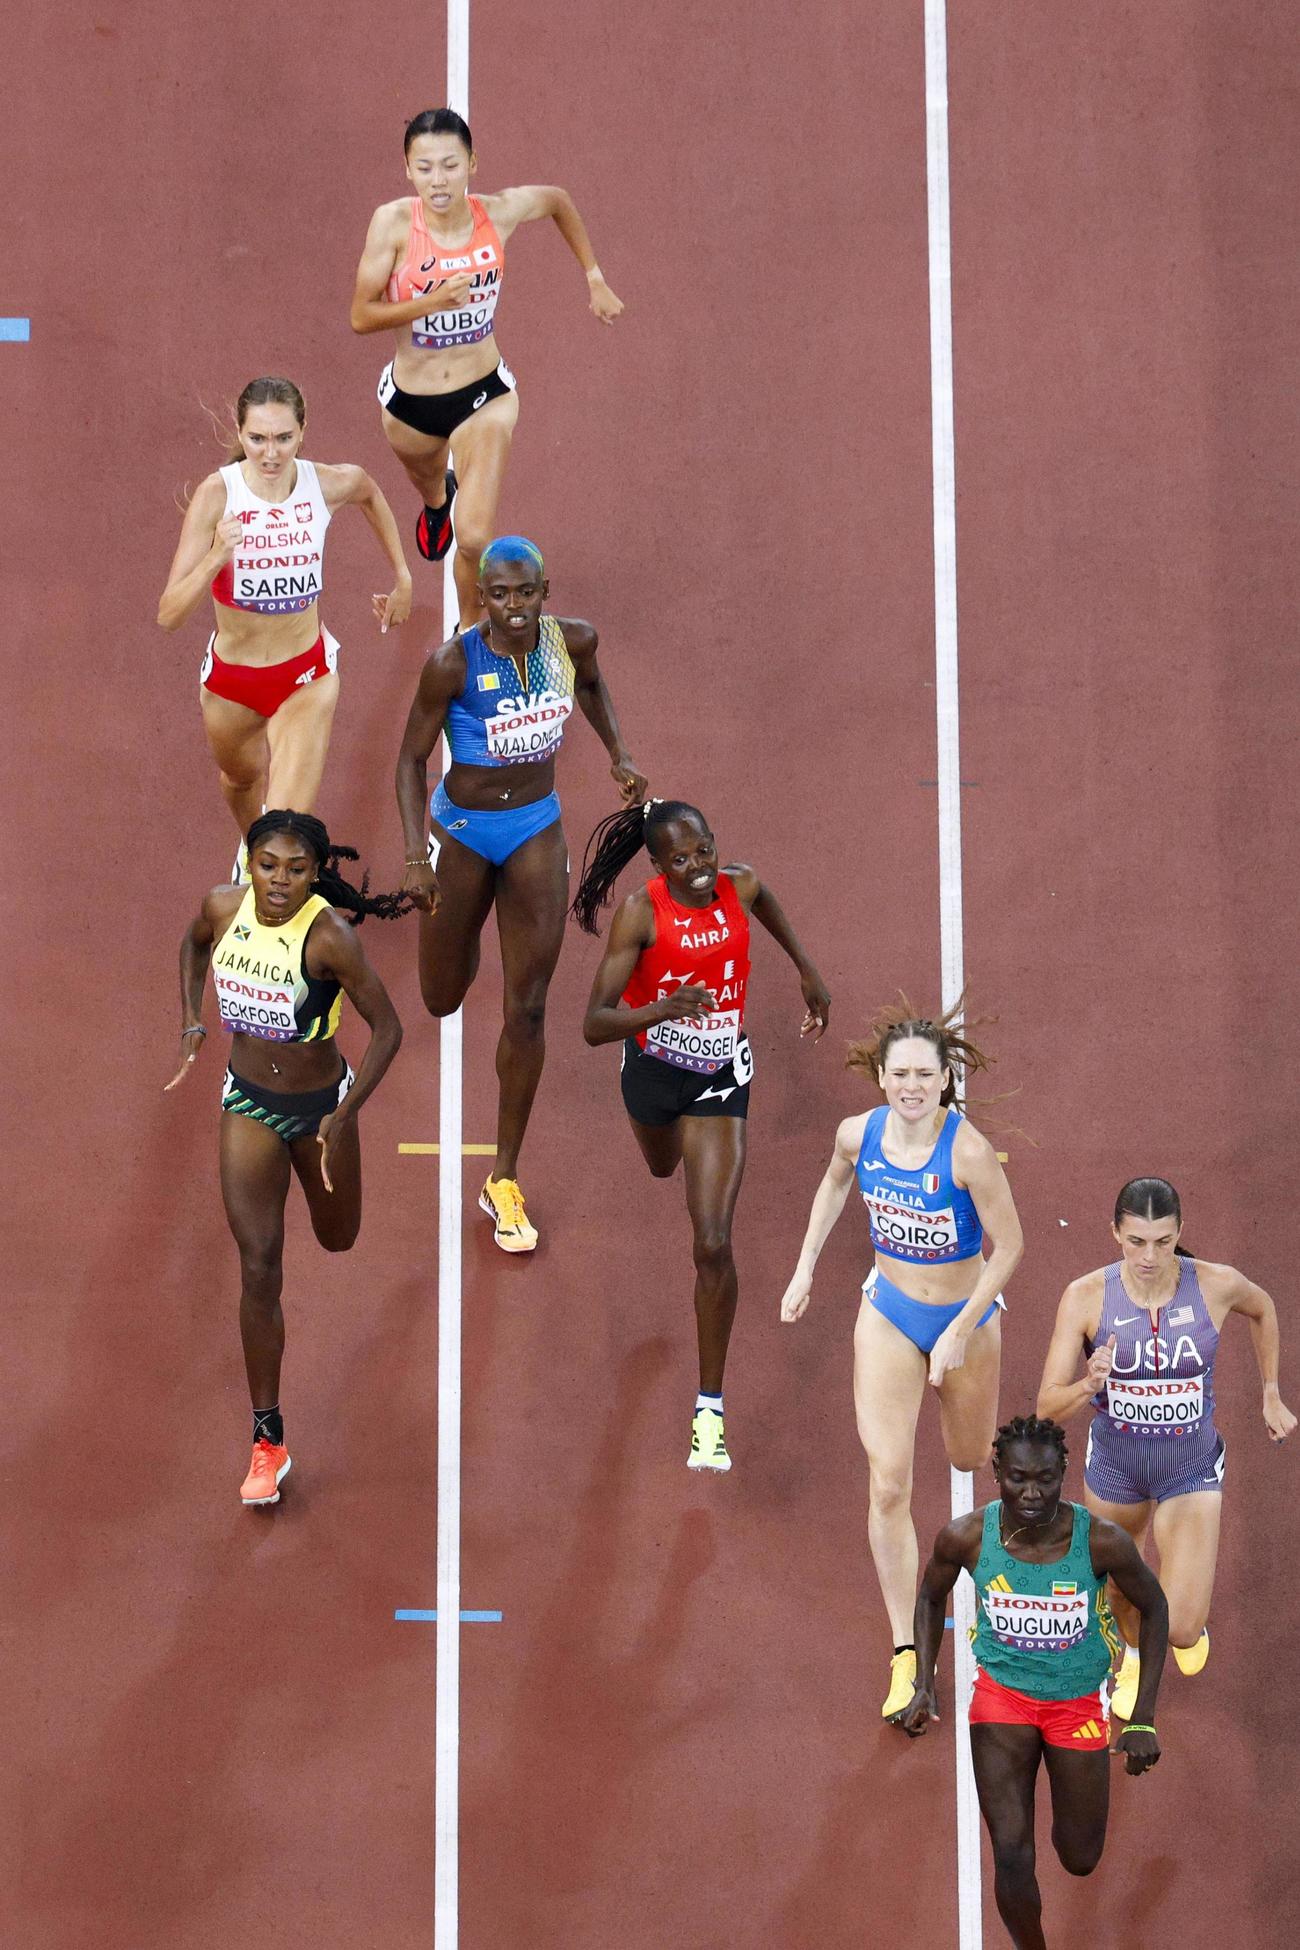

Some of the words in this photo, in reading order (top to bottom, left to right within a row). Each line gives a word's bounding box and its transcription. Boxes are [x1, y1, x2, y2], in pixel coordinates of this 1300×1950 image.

[424, 308, 487, 333] KUBO
[243, 530, 312, 549] POLSKA
[236, 552, 321, 570] HONDA
[240, 572, 318, 597] SARNA
[489, 704, 570, 736] HONDA
[216, 950, 295, 986] JAMAICA
[216, 977, 292, 1003] HONDA
[219, 998, 291, 1028] ECKFORD
[651, 1025, 734, 1057] JEPKOSGEI
[740, 1046, 751, 1076] 9
[873, 1185, 926, 1209] ITALIA
[866, 1200, 952, 1226] HONDA
[877, 1215, 950, 1247] COIRO
[1111, 1335, 1204, 1373] USA
[1108, 1380, 1201, 1397] HONDA
[1113, 1399, 1199, 1422] CONGDON
[992, 1596, 1086, 1613] HONDA
[996, 1615, 1083, 1636] DUGUMA
